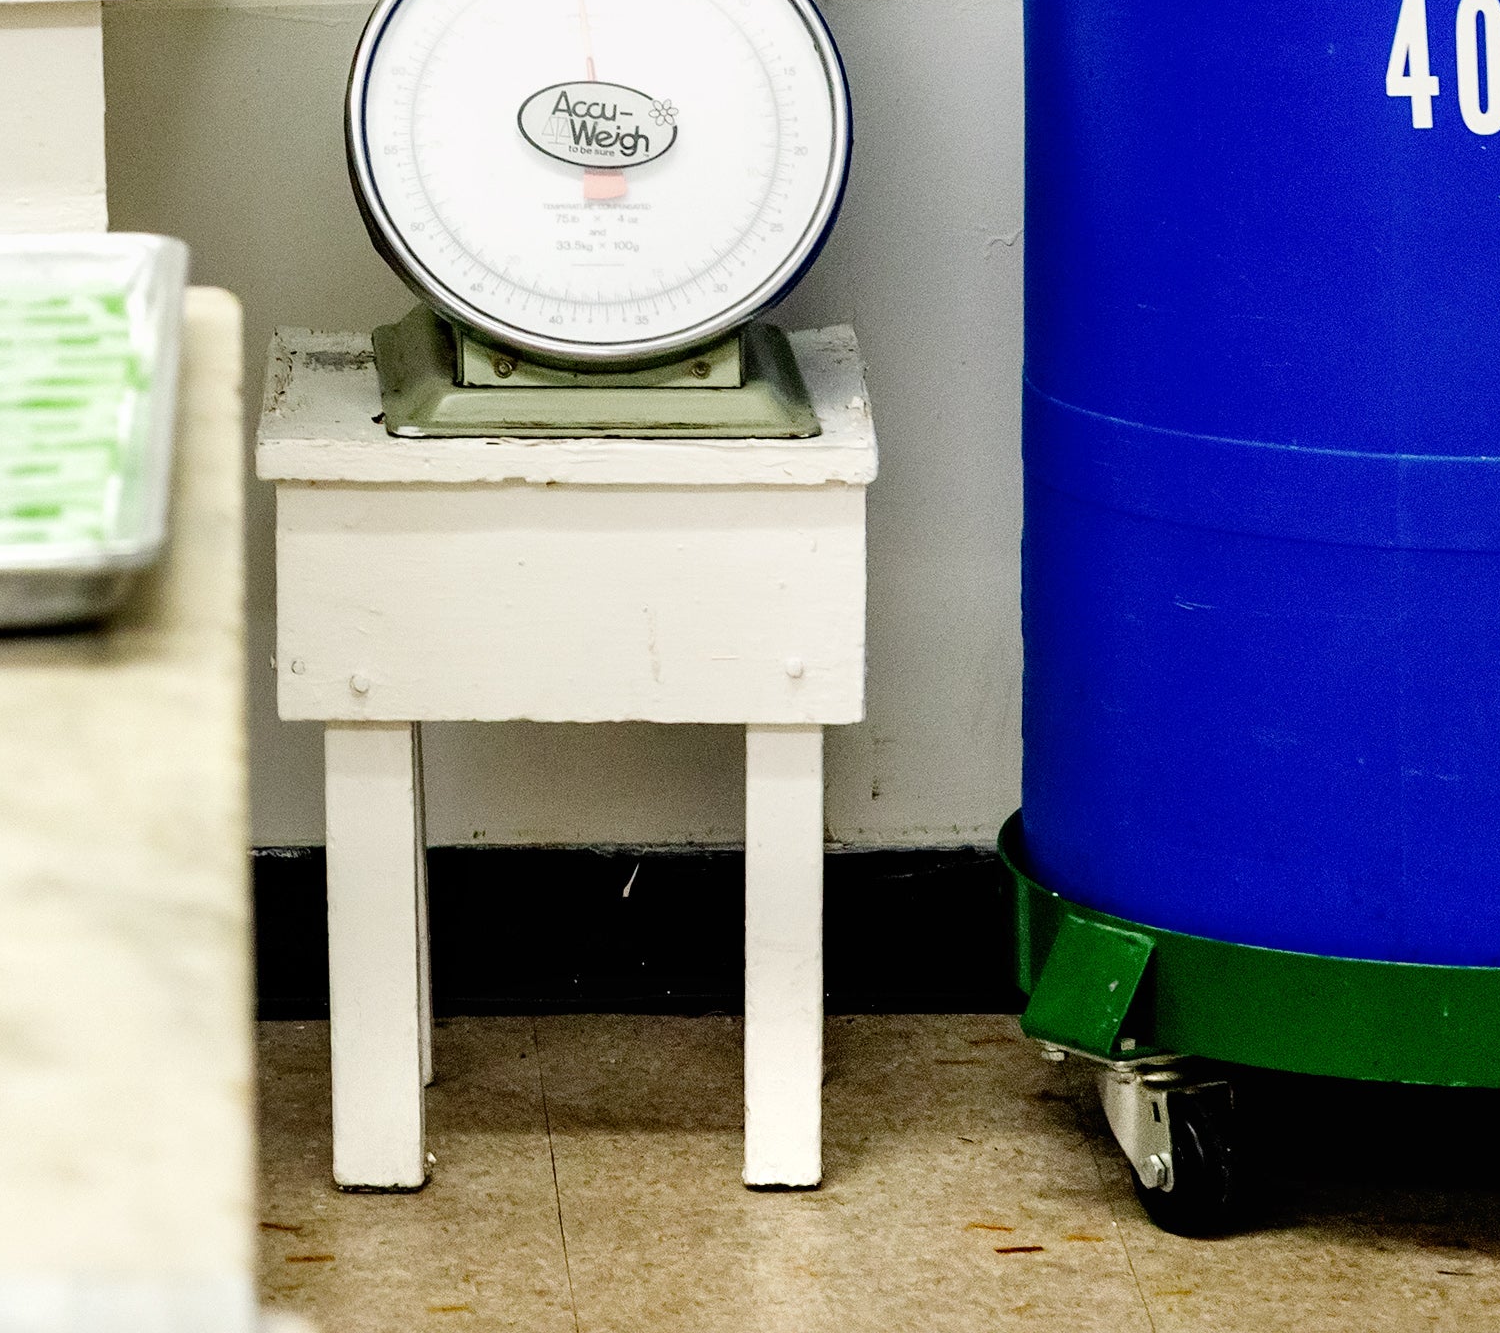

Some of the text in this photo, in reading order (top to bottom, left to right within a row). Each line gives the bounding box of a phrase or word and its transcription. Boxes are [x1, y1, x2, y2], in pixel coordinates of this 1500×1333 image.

[552, 90, 633, 122] Accu-
[569, 118, 650, 157] Weigh
[568, 144, 615, 157] to be sure
[793, 146, 808, 156] 20
[617, 214, 625, 223] 4
[589, 229, 607, 237] and
[769, 223, 784, 233] 25
[470, 282, 484, 293] 45
[713, 283, 728, 293] 30
[548, 315, 563, 325] 40
[634, 315, 649, 326] 35
